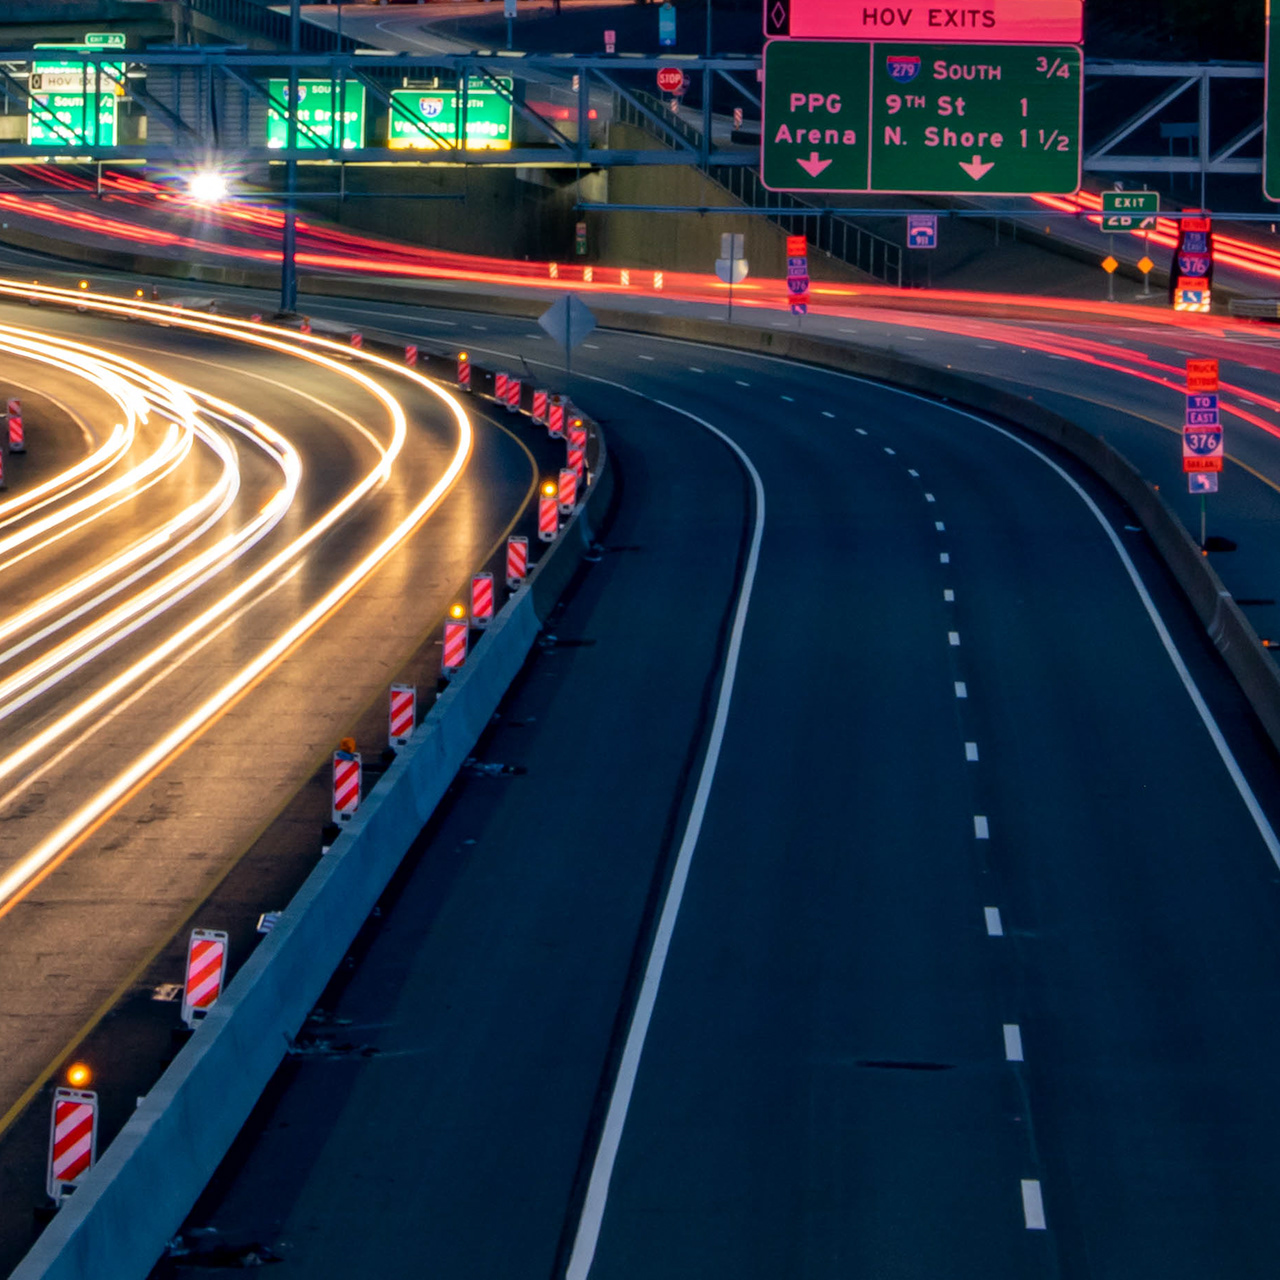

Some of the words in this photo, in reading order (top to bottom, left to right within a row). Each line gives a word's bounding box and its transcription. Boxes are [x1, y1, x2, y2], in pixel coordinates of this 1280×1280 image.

[862, 8, 912, 26] HOV
[928, 9, 997, 28] EXITS
[660, 73, 681, 83] STOP
[891, 63, 915, 77] 279
[933, 61, 1002, 81] SOUTH
[1035, 57, 1070, 79] 3/4
[790, 94, 842, 114] PPG
[938, 96, 966, 116] St
[1020, 99, 1028, 117] 1
[775, 124, 856, 144] Arena
[884, 127, 908, 146] N.
[924, 128, 1003, 148] Shore
[1115, 198, 1145, 208] EXIT
[1181, 257, 1206, 273] 376
[1195, 397, 1210, 407] TO
[1191, 412, 1214, 423] EAST
[1190, 434, 1217, 449] 376
